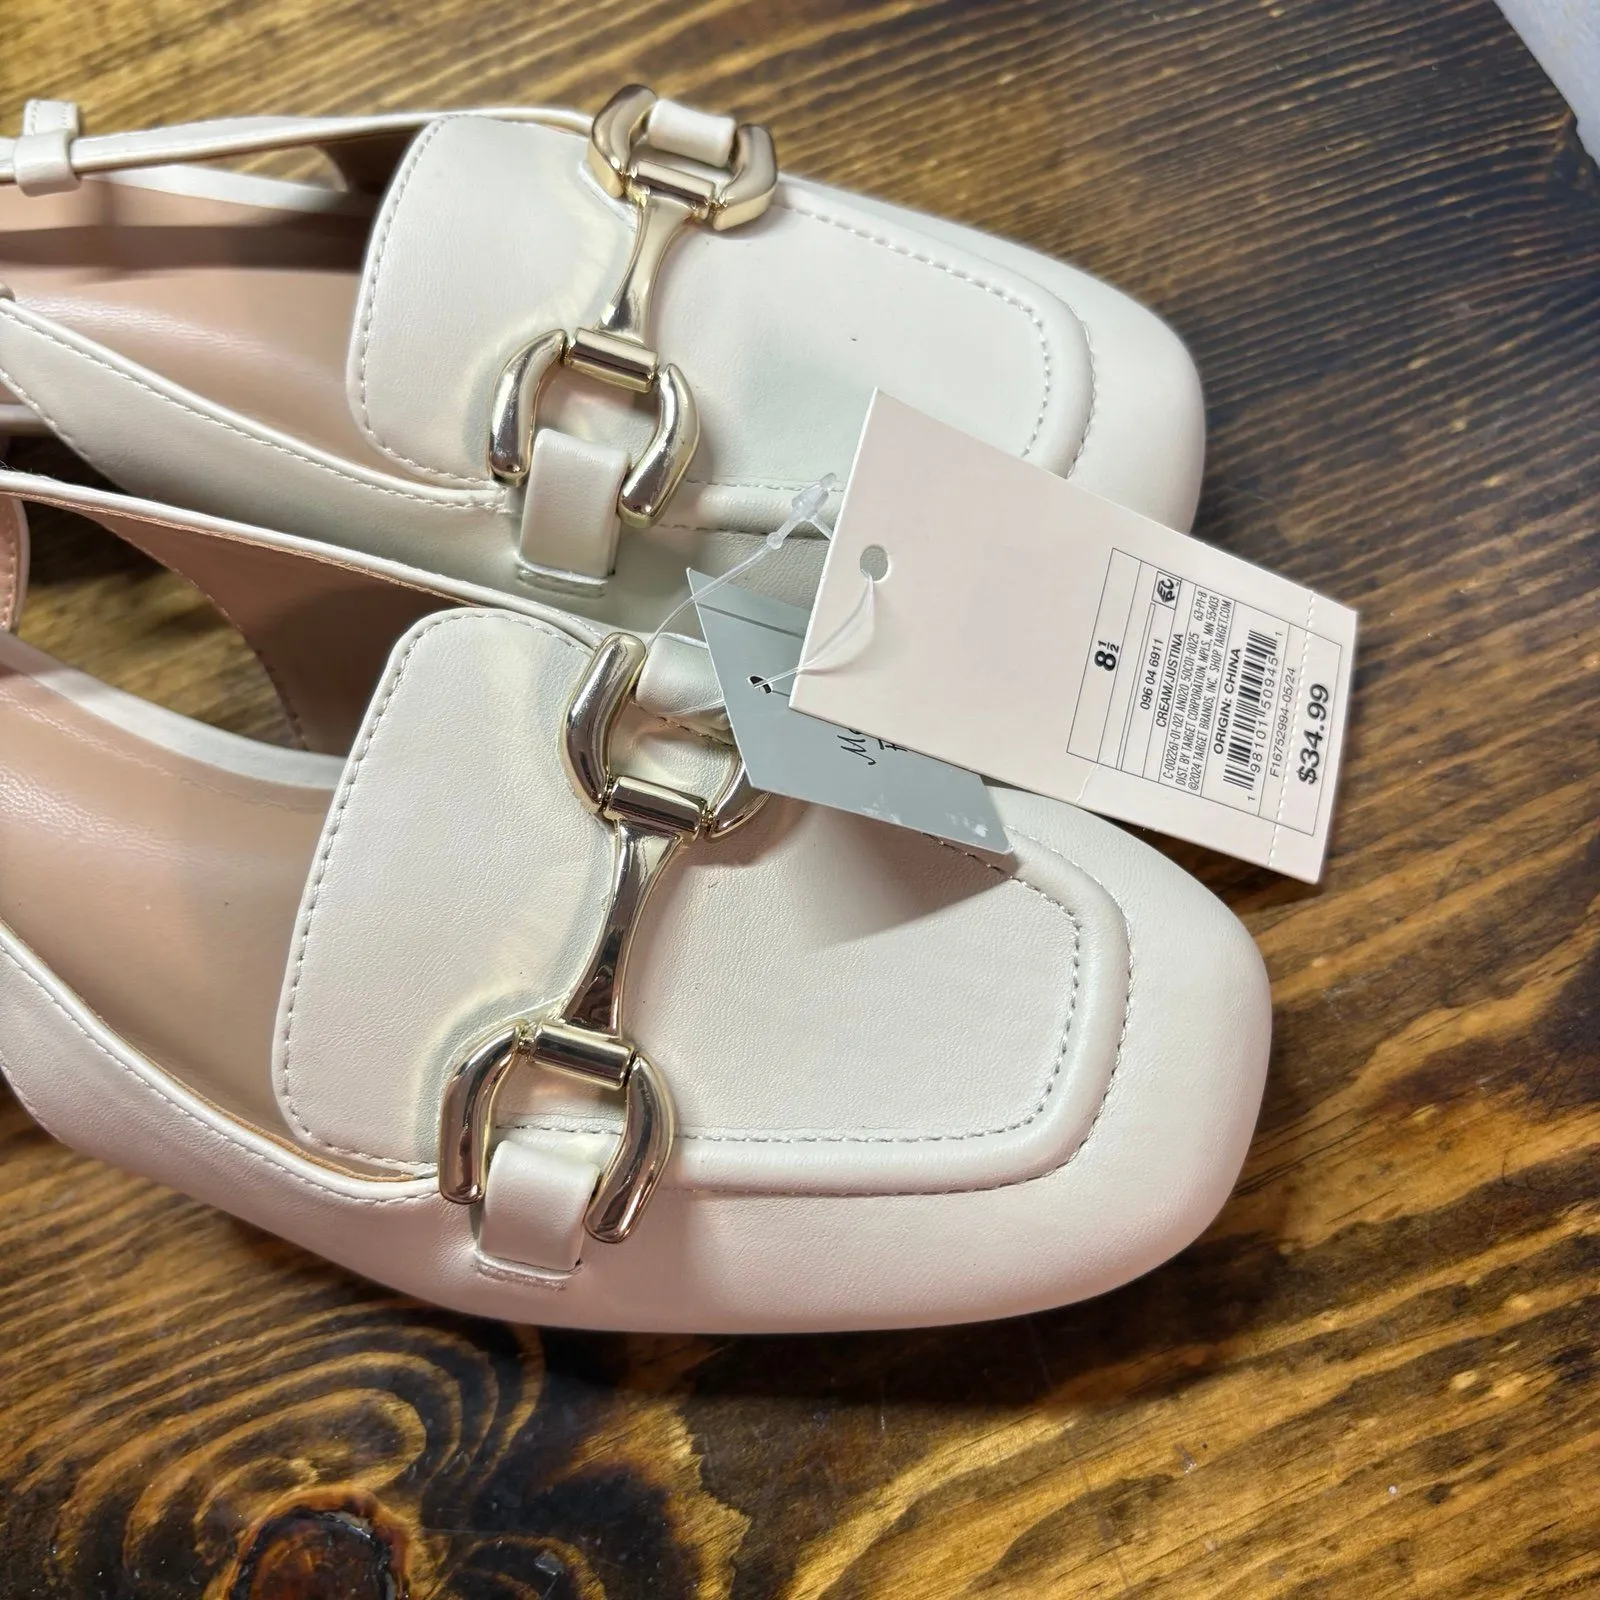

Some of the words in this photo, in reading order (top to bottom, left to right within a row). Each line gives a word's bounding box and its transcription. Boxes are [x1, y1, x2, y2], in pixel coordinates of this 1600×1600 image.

[1206, 595, 1220, 622] 55403
[1203, 622, 1214, 636] MN
[1214, 599, 1232, 648] TARGET.COM
[1149, 639, 1163, 667] 6911
[1209, 649, 1222, 673] SHOP
[1145, 670, 1157, 685] 04
[1156, 634, 1184, 727] CREAM/JUSTINA
[1205, 677, 1218, 693] INC.
[1140, 687, 1153, 710] 096
[1199, 696, 1216, 730] BRANDS,
[1213, 698, 1232, 754] ORIGIN:
[1224, 649, 1241, 694] CHINA
[1250, 721, 1268, 773] 98101
[1261, 656, 1279, 709] 50945
[1270, 667, 1296, 778] F16752994-05/24
[1163, 712, 1184, 779] C-002261-01-021
[1181, 721, 1196, 752] TARGET
[1193, 730, 1208, 761] TARGET
[1297, 683, 1329, 785] $34.99
[1179, 752, 1190, 765] BY
[1175, 766, 1189, 786] DIST.
[1188, 763, 1202, 791] ©2024
